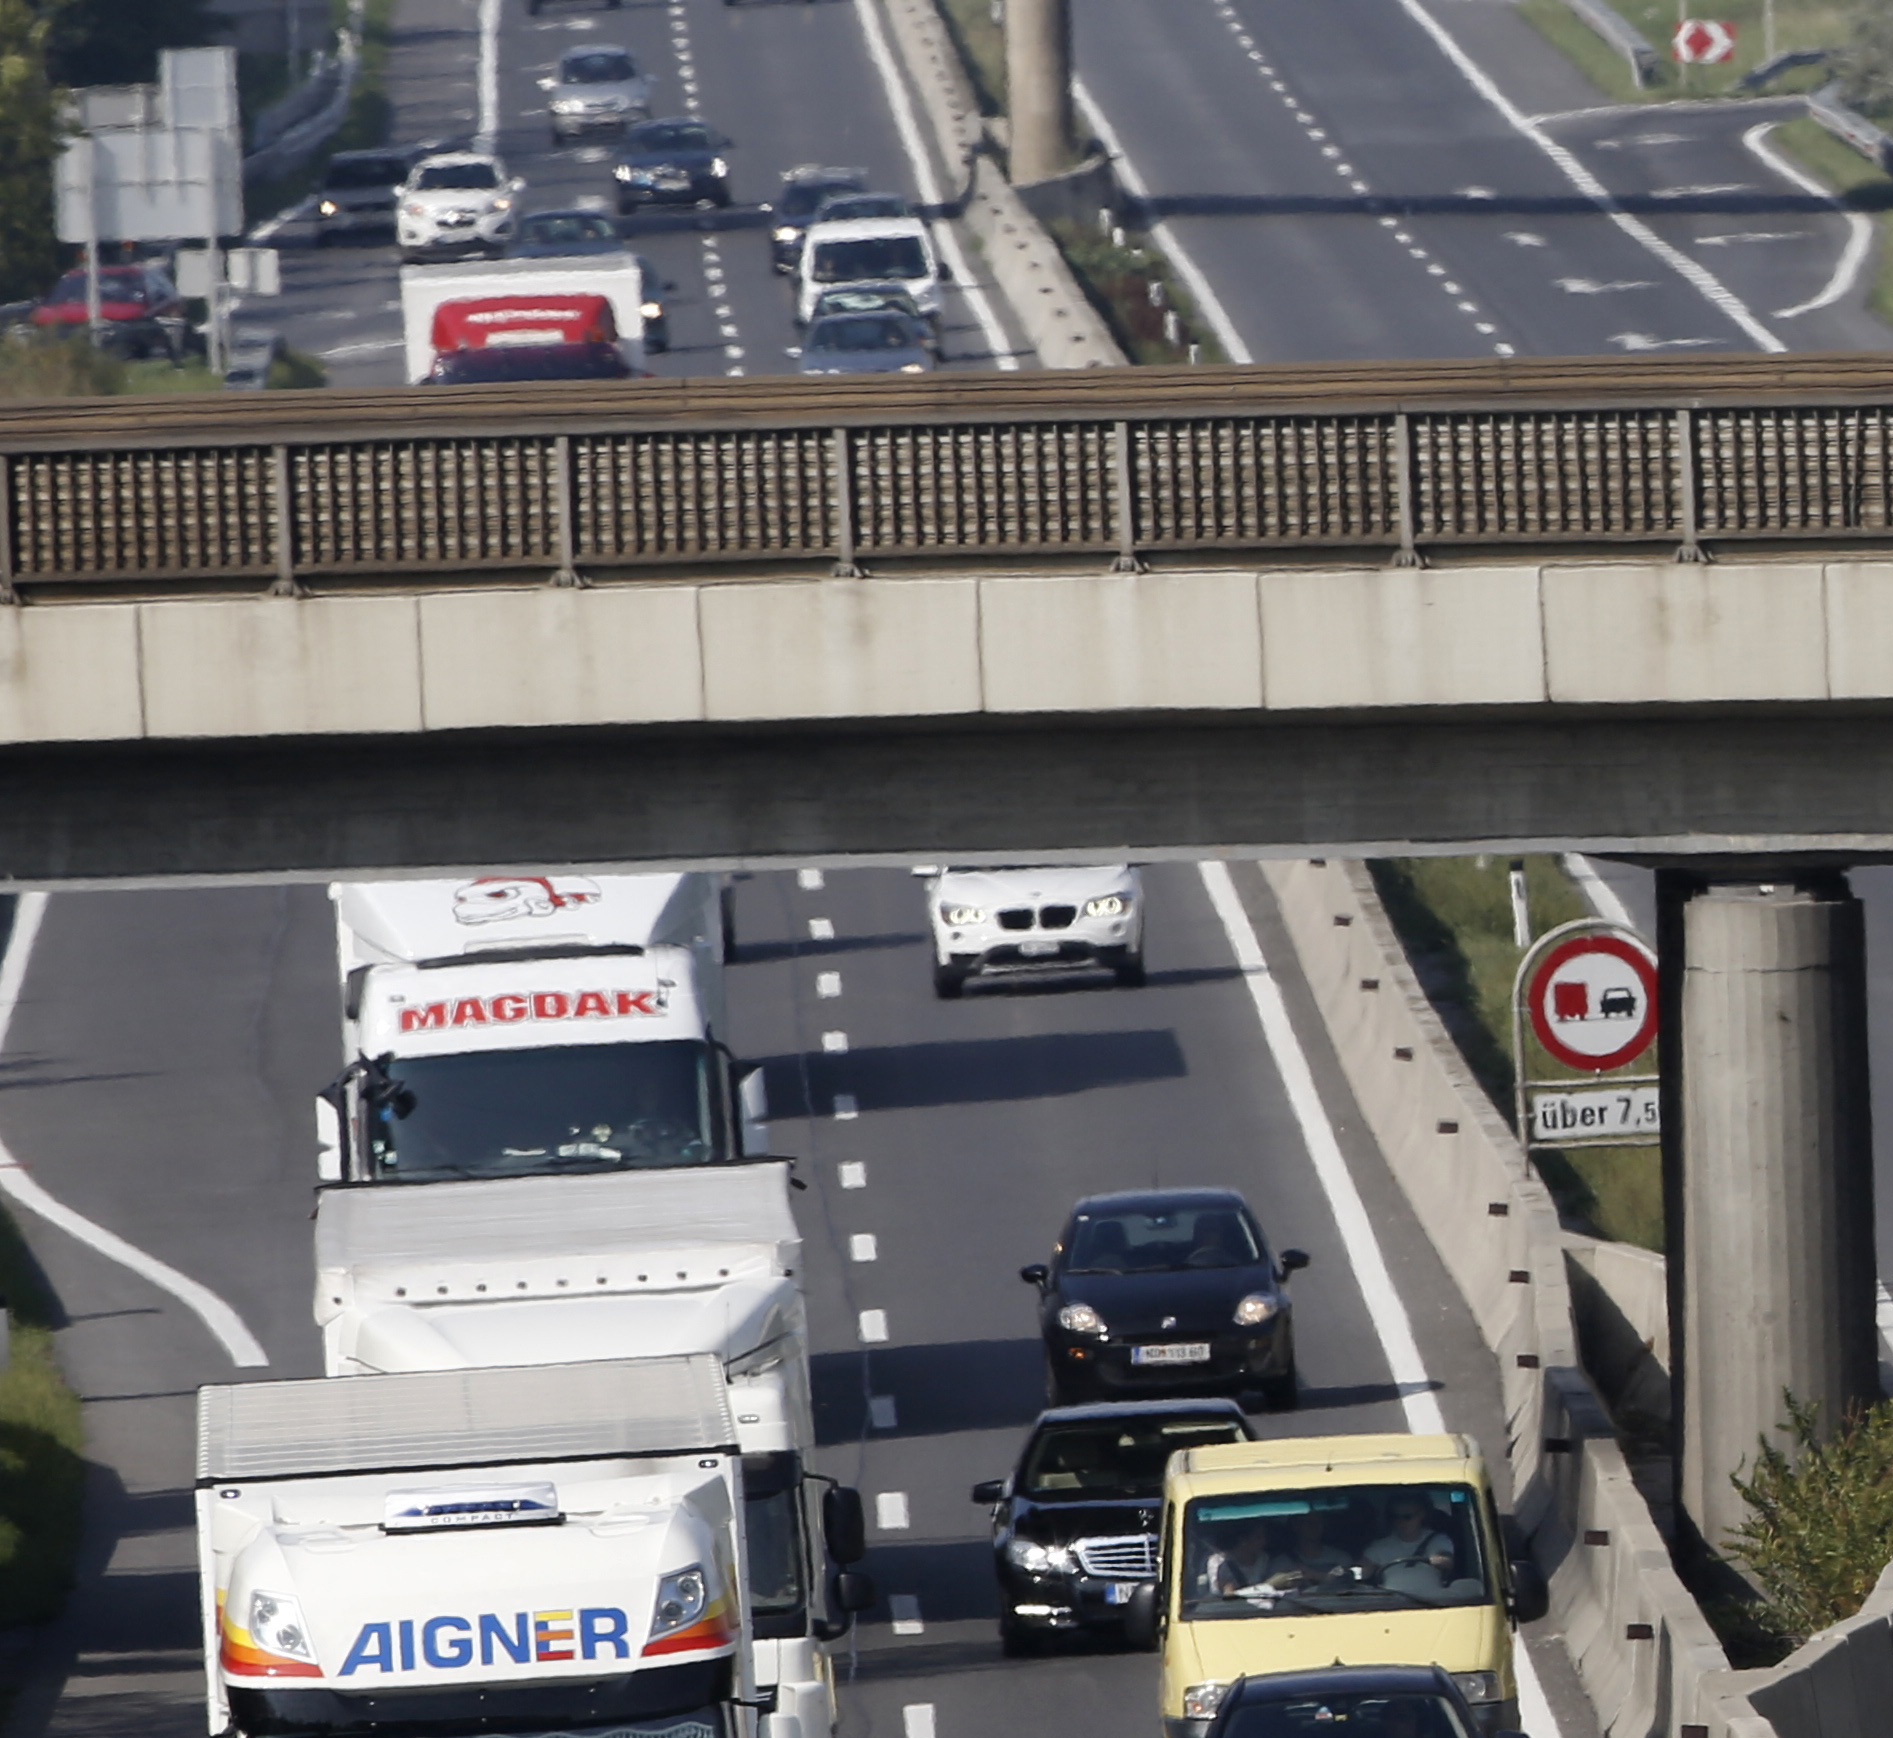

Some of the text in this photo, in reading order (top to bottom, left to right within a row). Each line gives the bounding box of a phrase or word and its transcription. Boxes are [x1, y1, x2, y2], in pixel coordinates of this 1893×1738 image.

[400, 990, 656, 1034] MAGDAK
[1541, 1102, 1607, 1130] über
[431, 1514, 513, 1524] COMPACT
[337, 1607, 630, 1677] AIGNER
